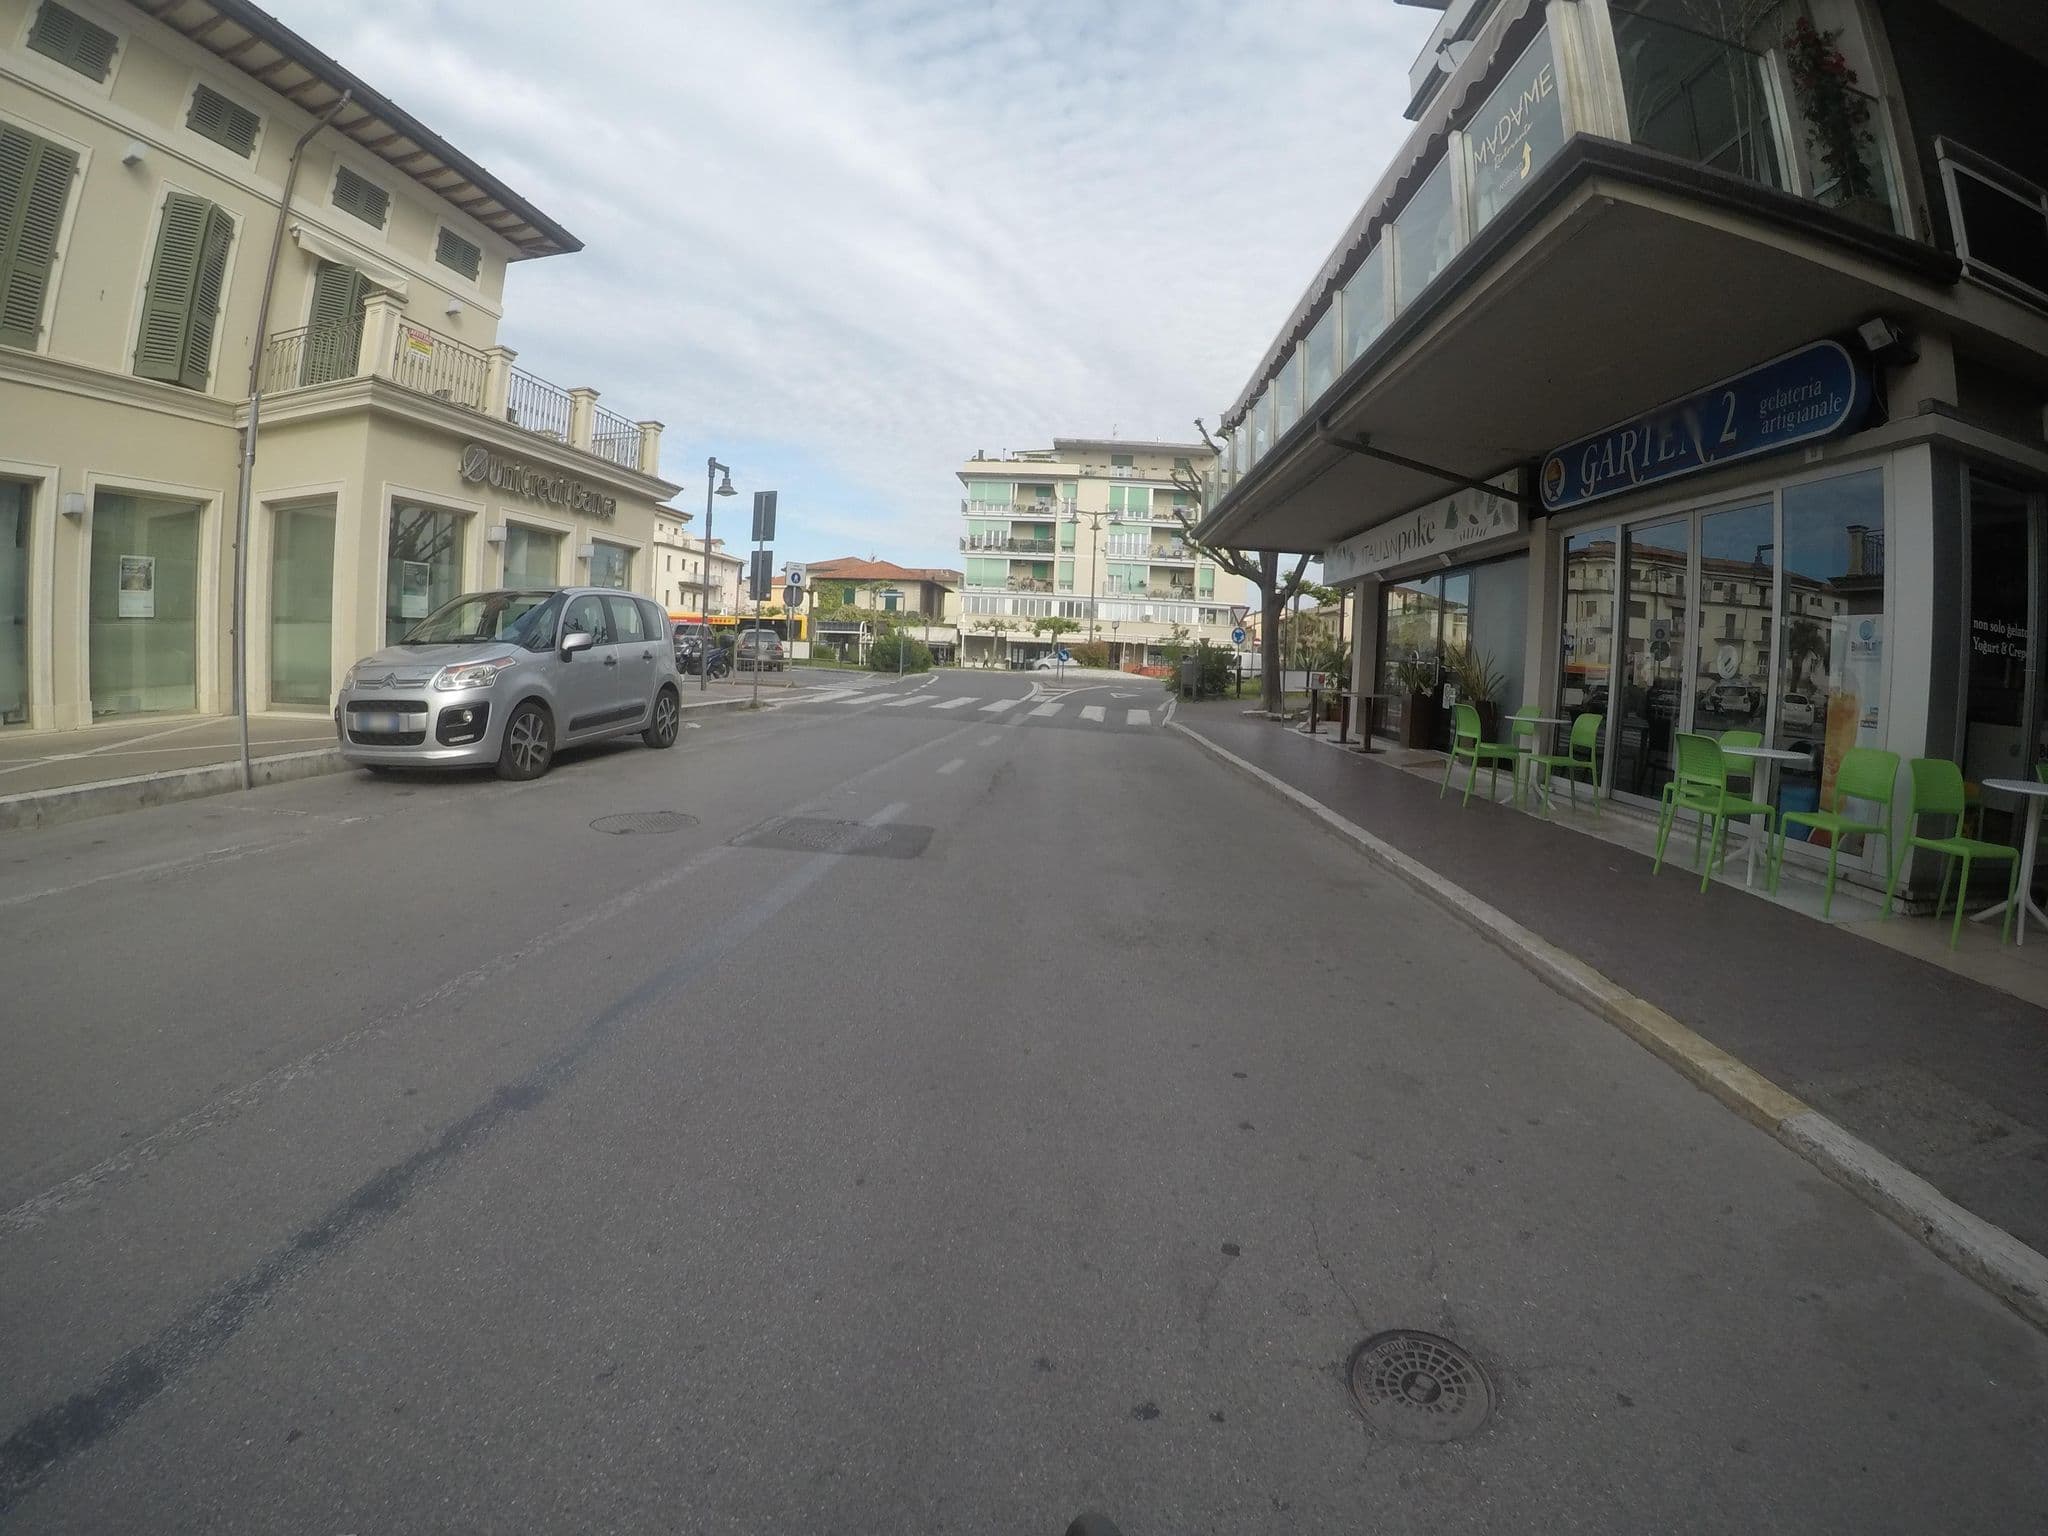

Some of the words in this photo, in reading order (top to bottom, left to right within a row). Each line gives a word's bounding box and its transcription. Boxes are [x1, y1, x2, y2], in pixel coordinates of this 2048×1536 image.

[1760, 377, 1822, 417] gelateria
[1761, 394, 1842, 432] artigianale
[1719, 391, 1737, 443] 2
[489, 454, 570, 504] UniCredit
[571, 480, 616, 521] Banca
[1973, 619, 1988, 631] non
[1990, 619, 2006, 634] solo
[1973, 636, 1999, 655] Yogurt
